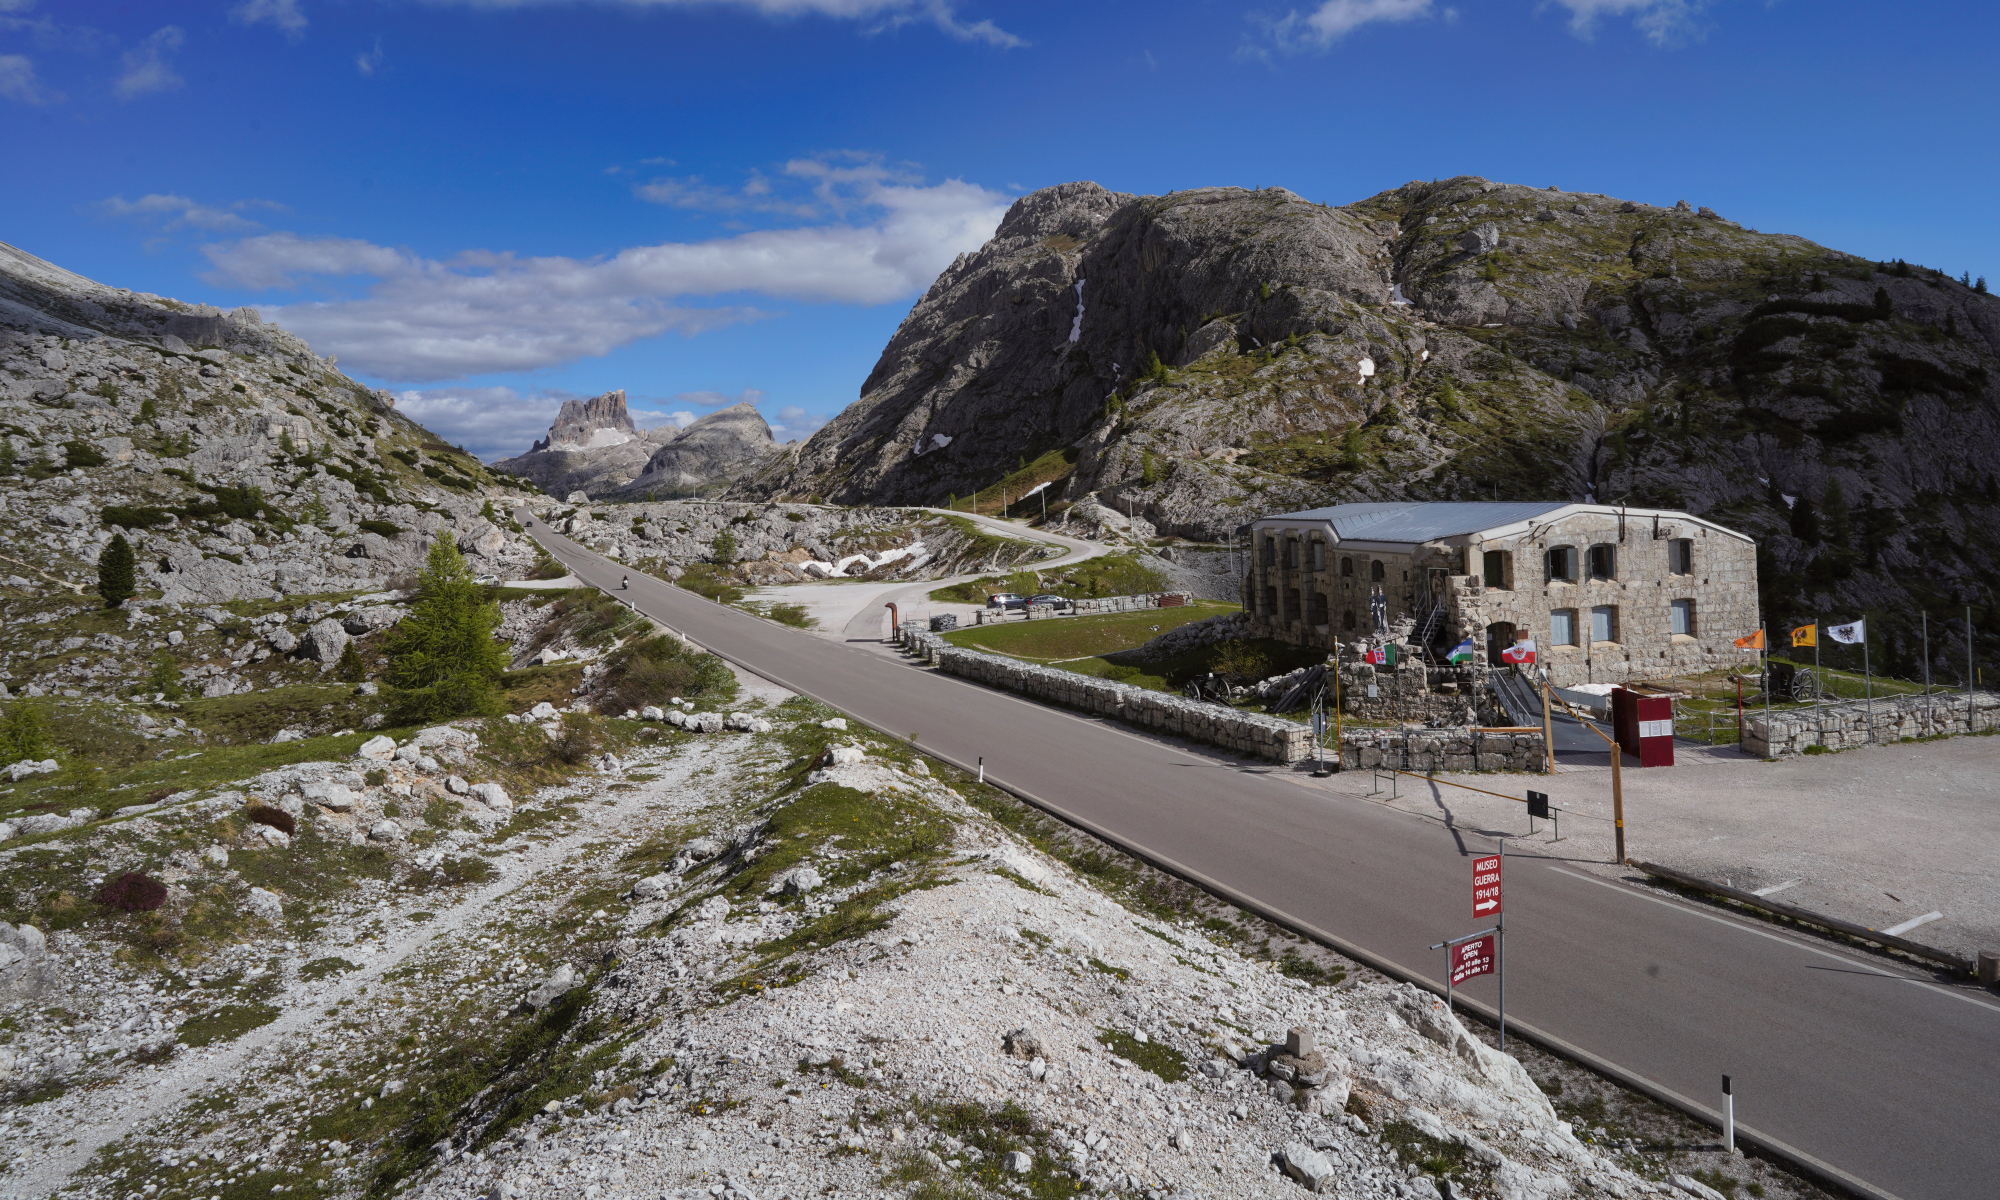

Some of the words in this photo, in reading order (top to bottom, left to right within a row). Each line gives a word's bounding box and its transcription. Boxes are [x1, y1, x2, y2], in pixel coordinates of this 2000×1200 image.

[1476, 859, 1498, 872] MUSEO
[1474, 873, 1500, 886] GUERRA
[1476, 886, 1498, 900] 1914/18
[1461, 941, 1482, 954] APERTO
[1464, 950, 1478, 960] OPEN
[1454, 972, 1464, 982] dalle
